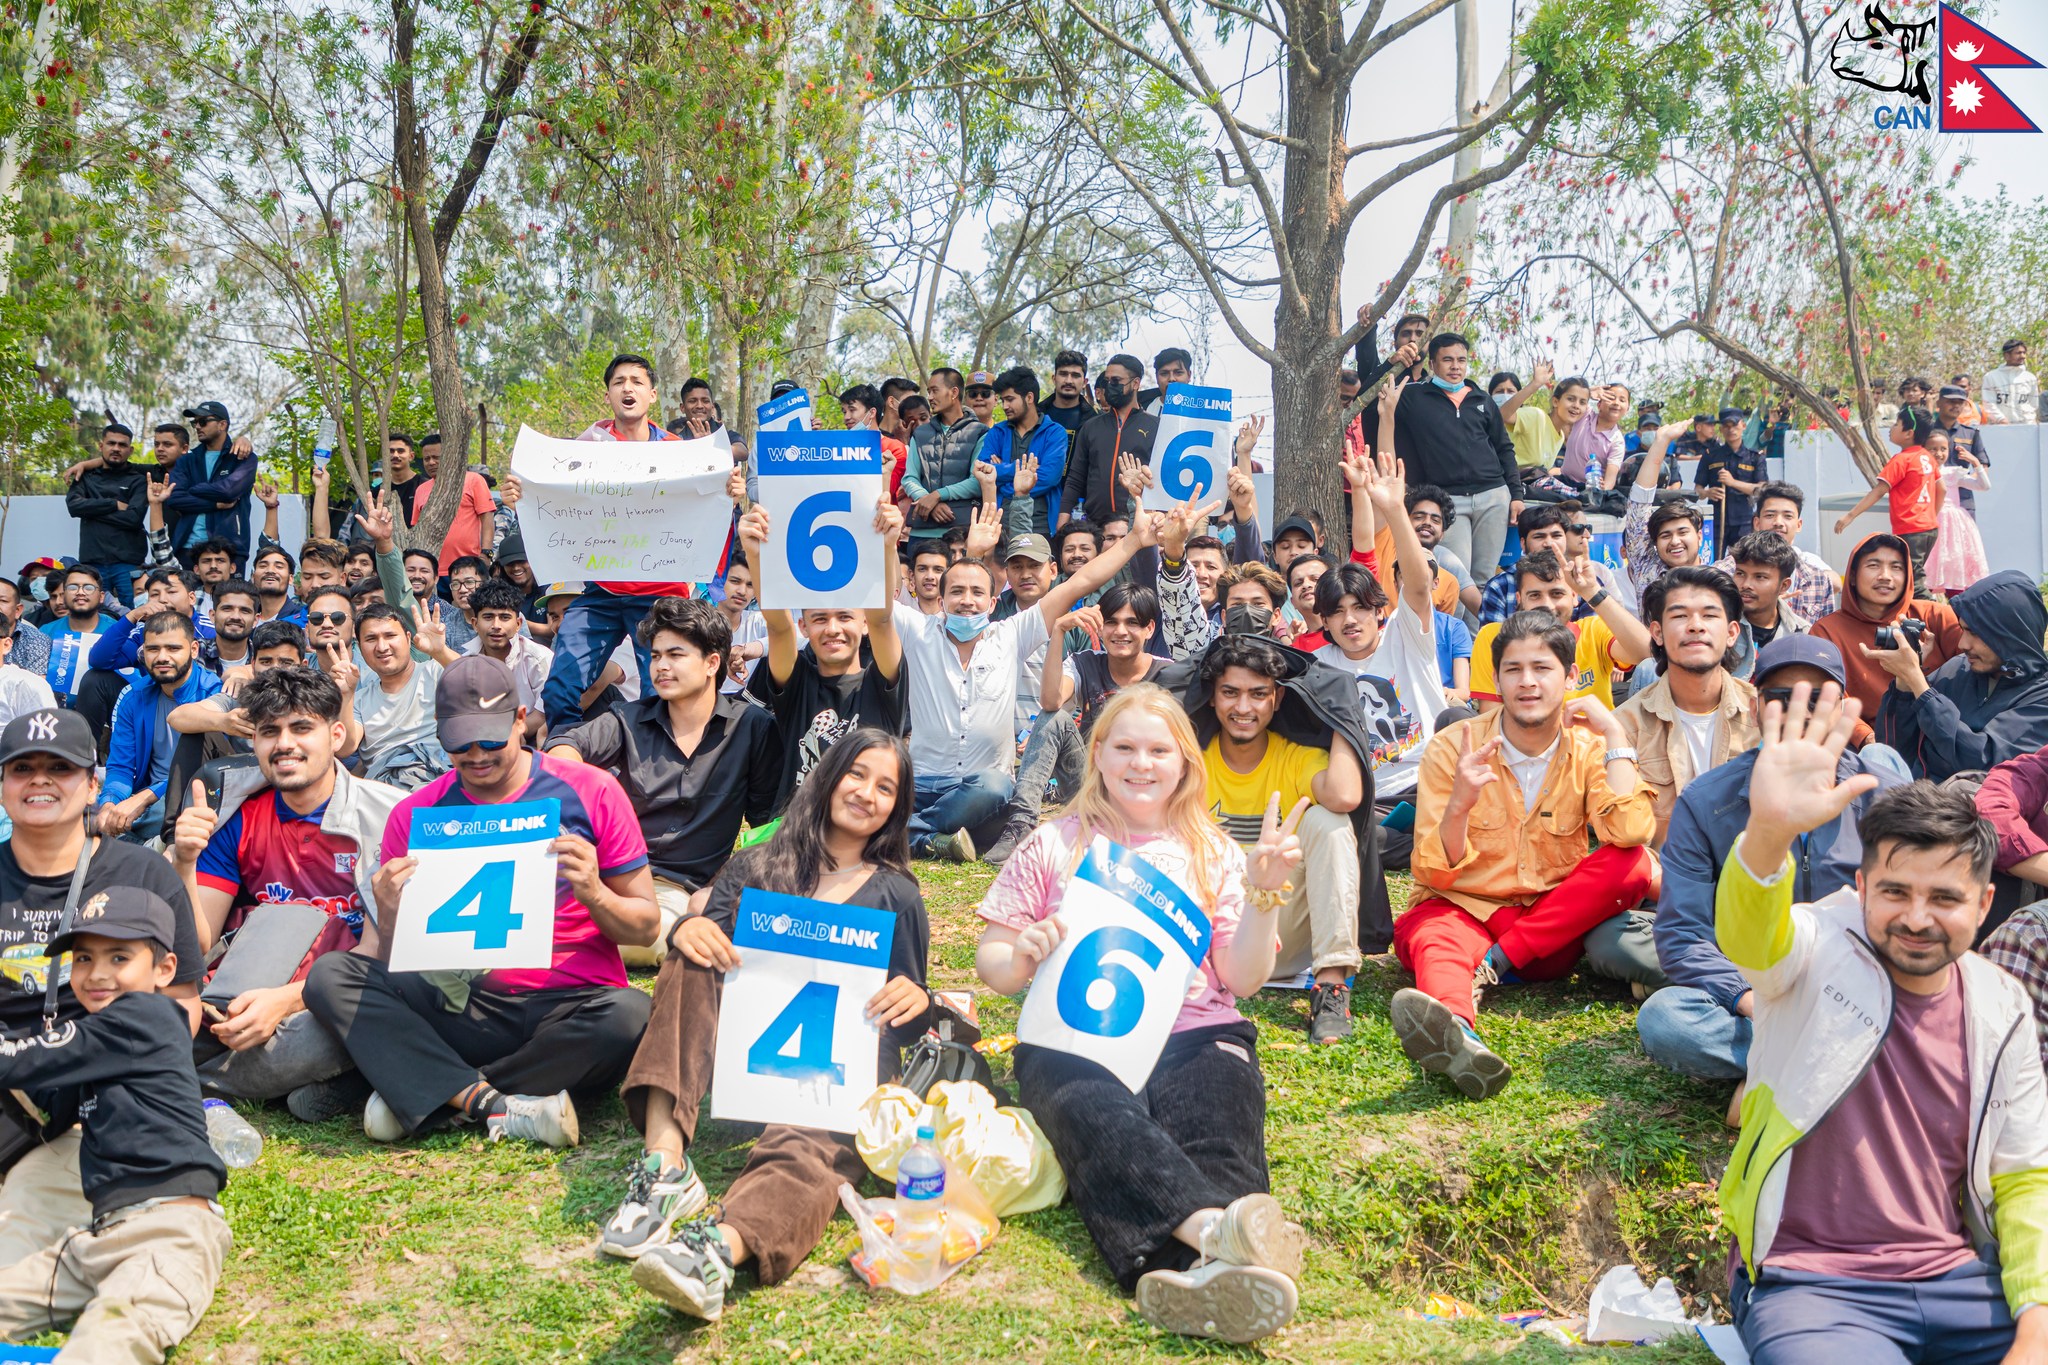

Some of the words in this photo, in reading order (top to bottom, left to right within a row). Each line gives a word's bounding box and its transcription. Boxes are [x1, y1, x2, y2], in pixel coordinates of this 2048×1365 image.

[1165, 393, 1231, 412] WORLDLINK
[768, 446, 872, 462] WORLDLINK
[1160, 430, 1214, 502] 6
[536, 496, 594, 520] Kantipur
[547, 531, 576, 548] Star
[786, 491, 859, 592] 6
[54, 633, 76, 686] WORLDLINK
[423, 814, 548, 837] WORLDLINK
[265, 881, 294, 903] My
[425, 860, 524, 950] 4
[1099, 858, 1203, 948] WORLDLINK
[31, 920, 51, 932] MY
[33, 930, 48, 943] TO
[751, 911, 881, 950] WORLDLINK
[1056, 925, 1165, 1038] 6
[1823, 984, 1882, 1037] EDITION
[747, 980, 846, 1086] 4
